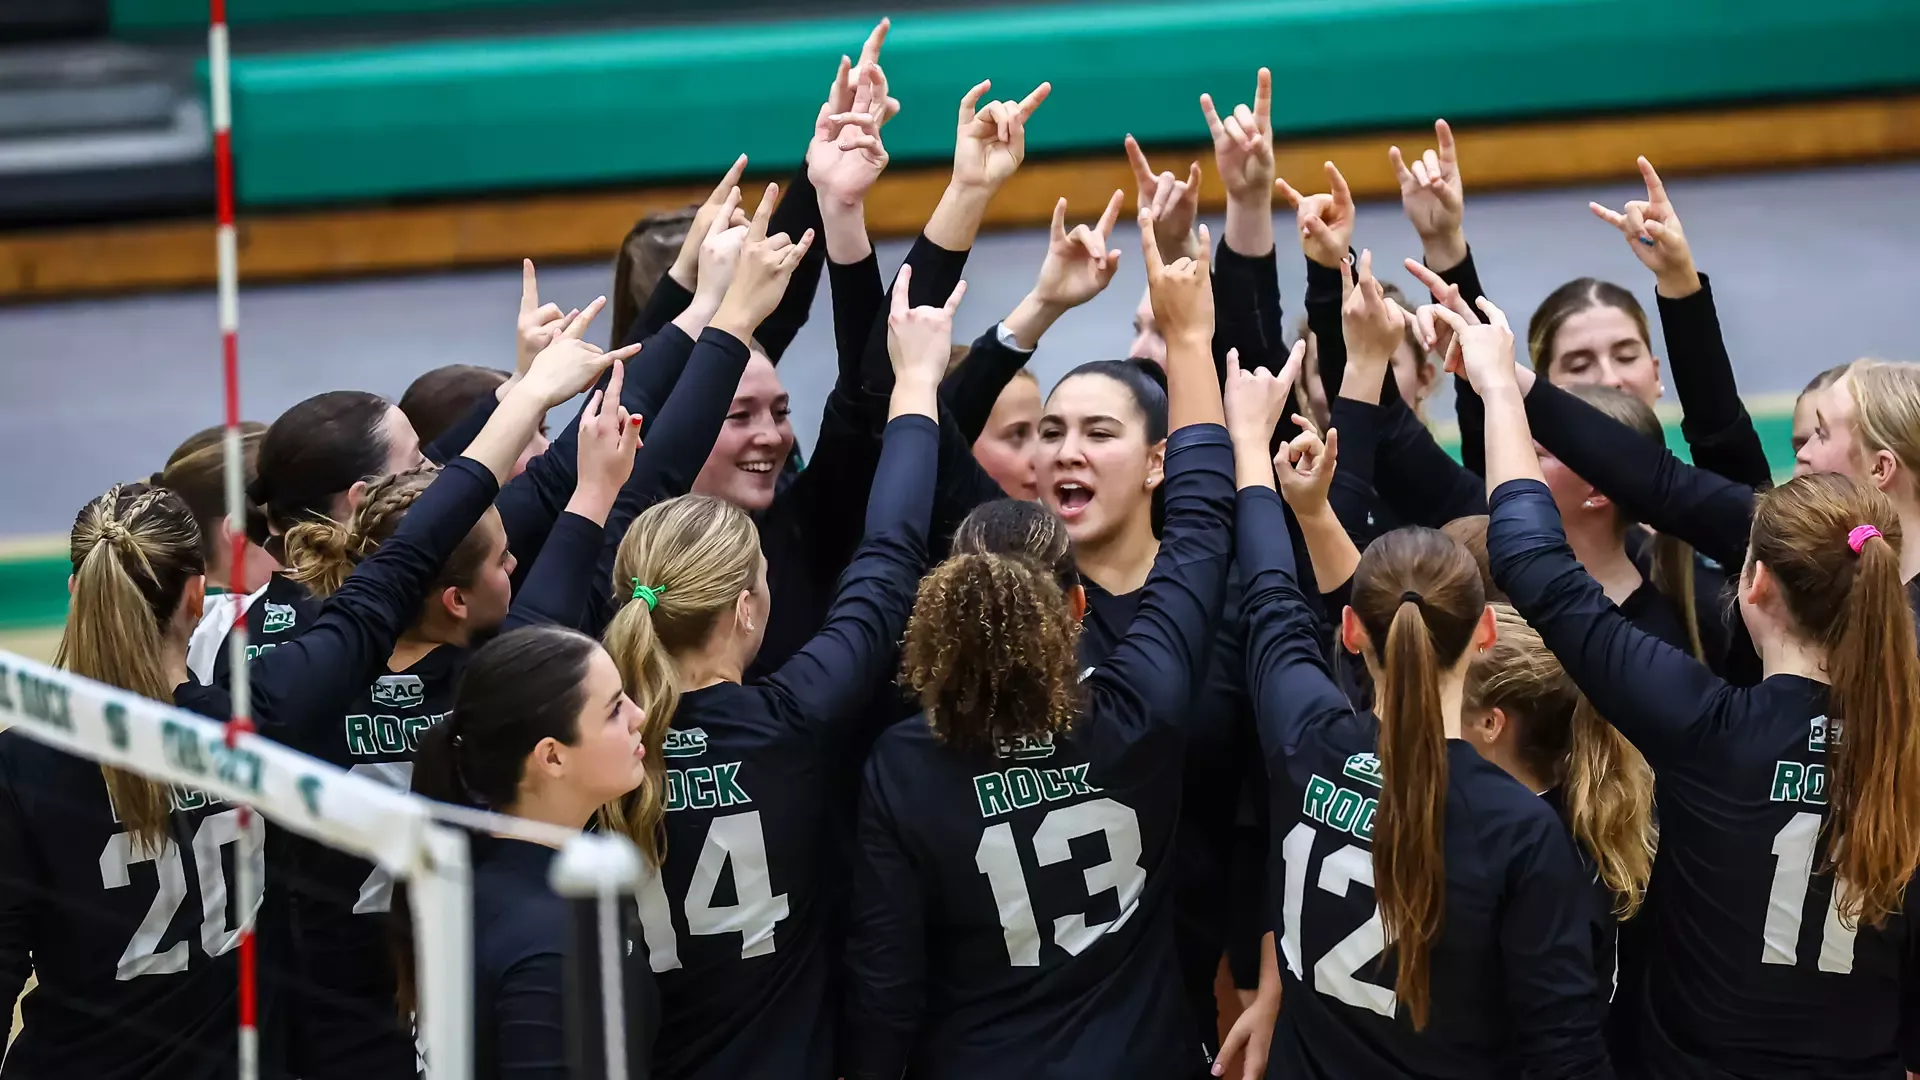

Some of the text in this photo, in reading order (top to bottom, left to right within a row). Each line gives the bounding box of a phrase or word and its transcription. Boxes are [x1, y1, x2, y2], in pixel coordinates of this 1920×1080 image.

[373, 683, 421, 700] PSAC
[346, 710, 454, 755] ROC
[663, 732, 704, 748] SAC
[663, 761, 752, 811] OCK
[973, 762, 1104, 818] ROCK
[1303, 774, 1379, 842] ROC
[1770, 760, 1828, 804] RO
[99, 802, 265, 981] 20
[634, 810, 789, 973] 14
[975, 797, 1147, 966] 13
[1281, 821, 1399, 1020] 12
